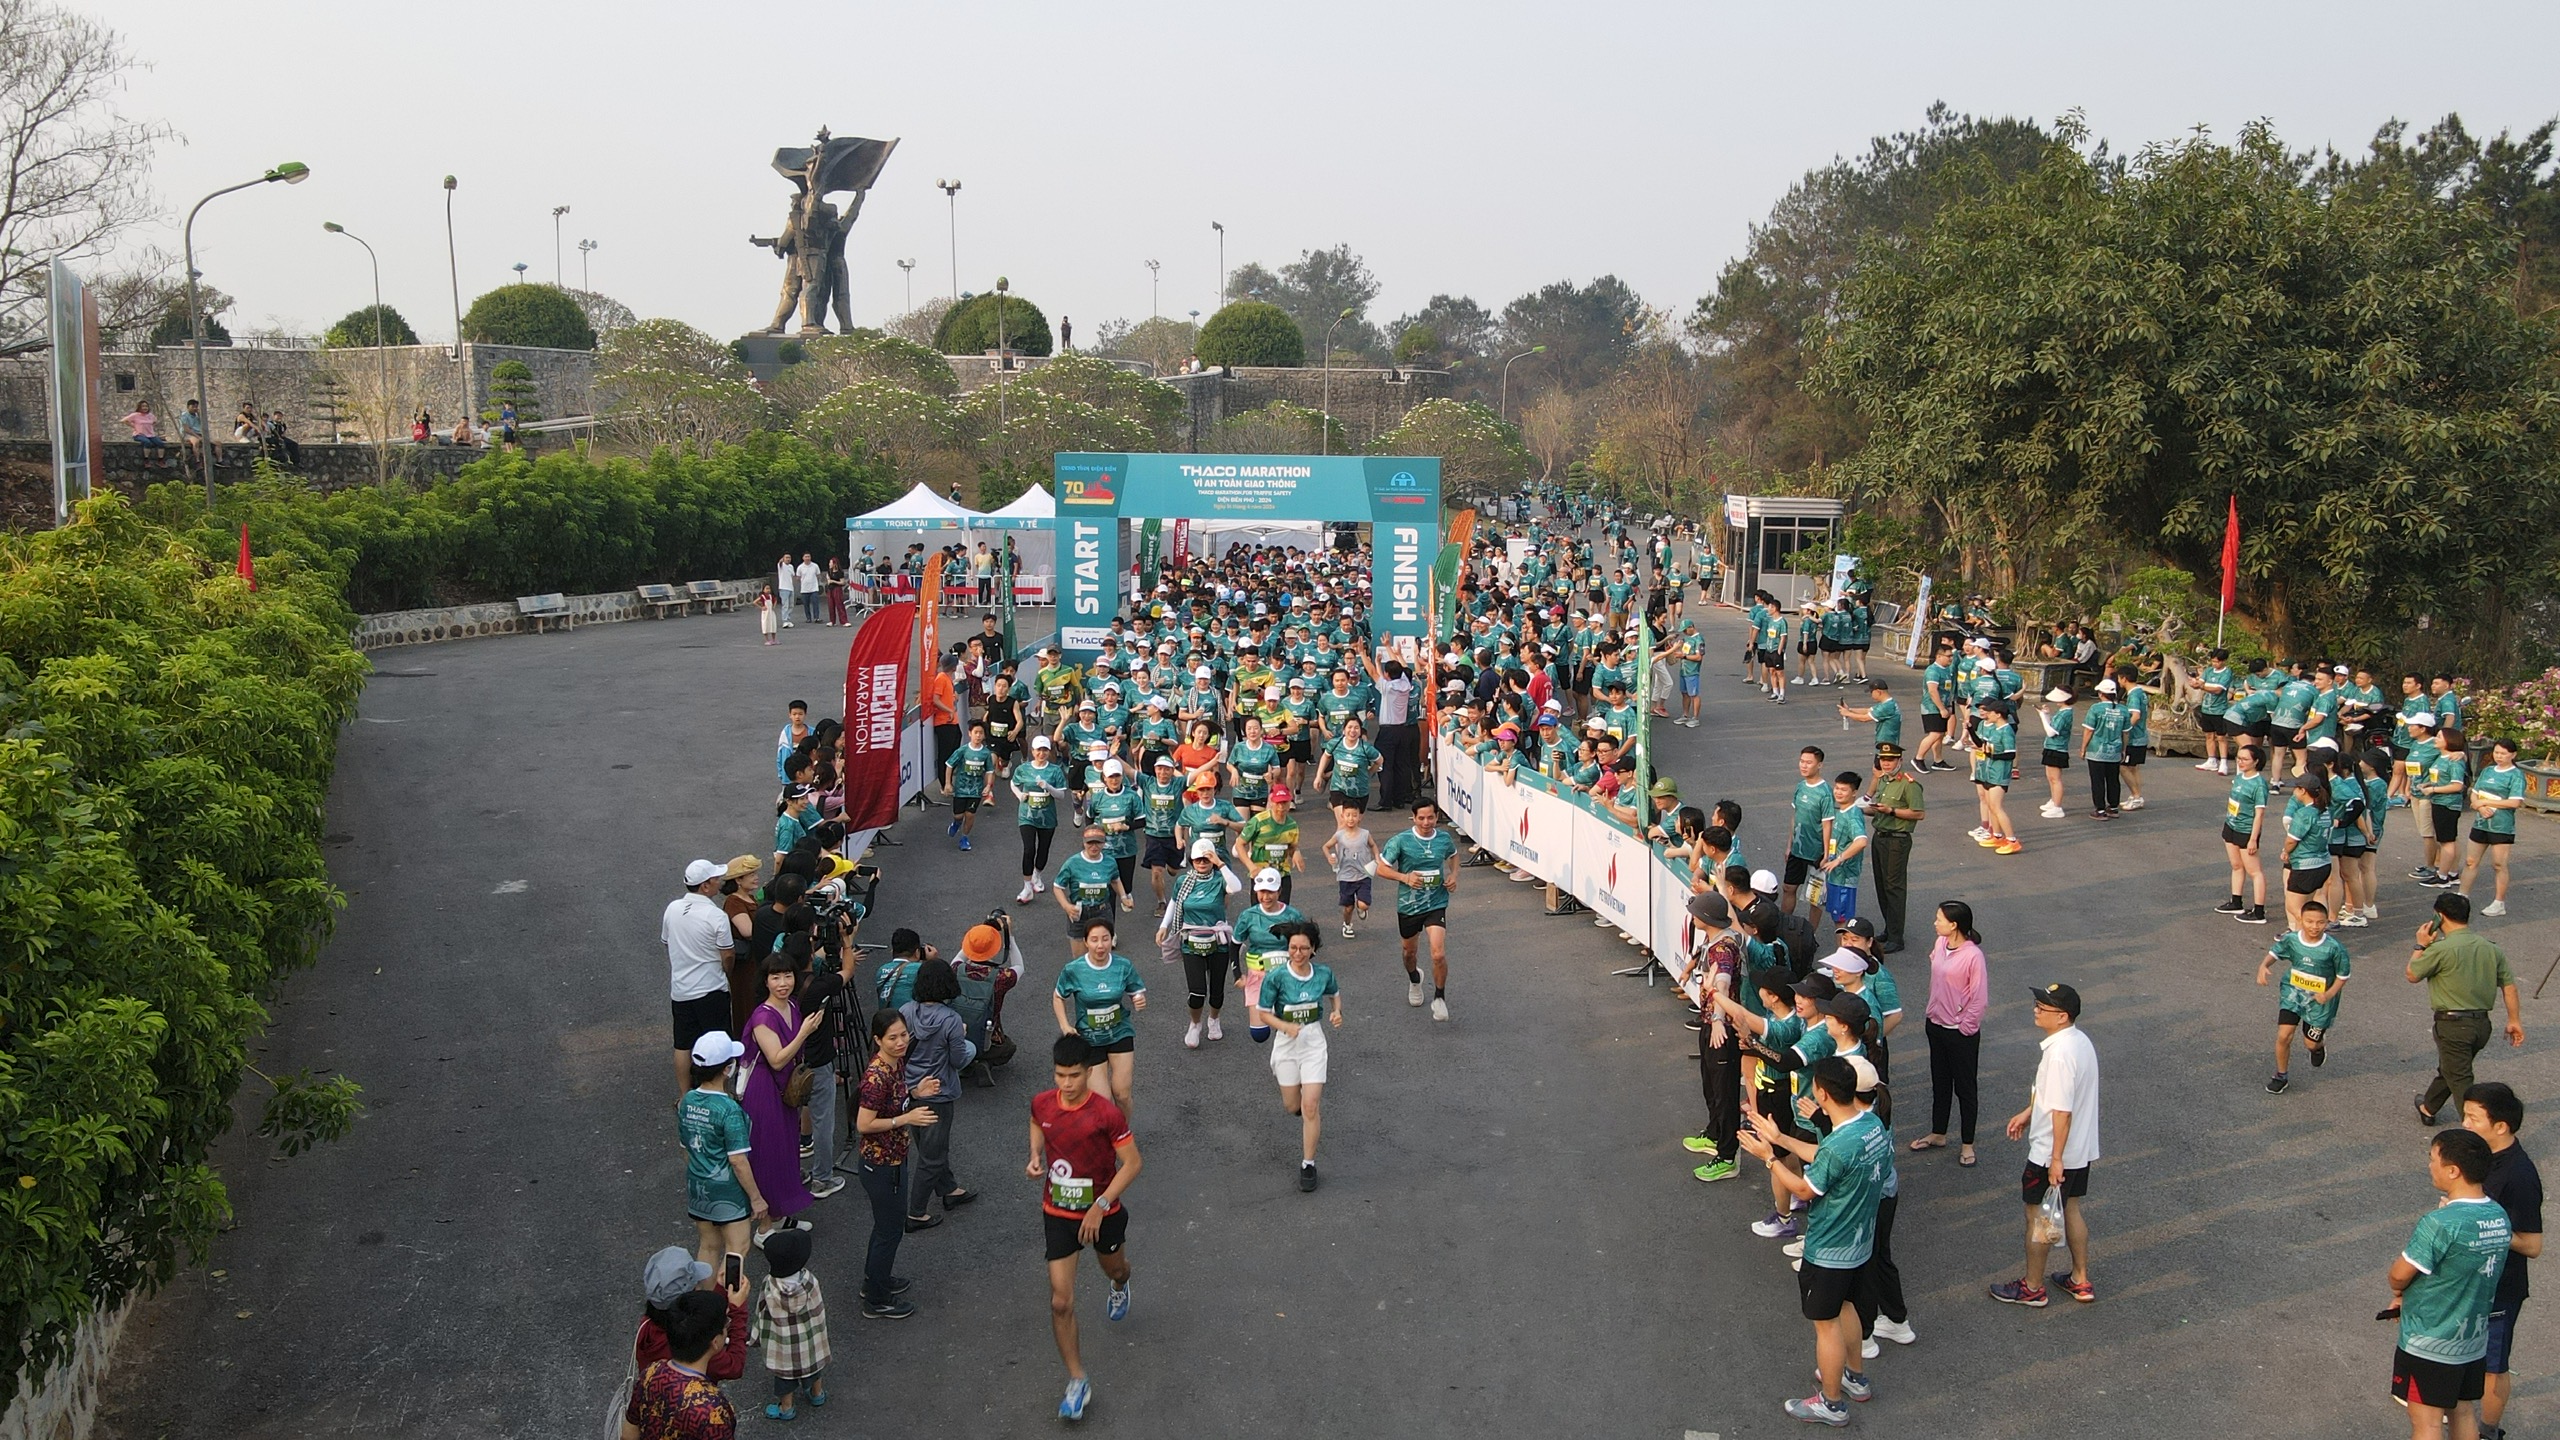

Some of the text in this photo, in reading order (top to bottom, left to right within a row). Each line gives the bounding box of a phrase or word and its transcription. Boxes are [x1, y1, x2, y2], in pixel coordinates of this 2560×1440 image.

[1180, 465, 1311, 477] THACO MARATHON
[1063, 481, 1084, 494] 70
[1193, 477, 1297, 488] VÌ AN TOÀN GIAO THÔNG
[884, 520, 912, 529] TRỌNG
[1019, 519, 1038, 528] Y TẾ
[1074, 521, 1099, 615] START
[1393, 527, 1418, 621] FINISH
[855, 667, 870, 754] MARATHON
[870, 664, 898, 750] DISCOVERY
[1446, 776, 1473, 815] THACO
[1509, 839, 1539, 865] PETROVIETNAM
[1598, 888, 1626, 917] PETROVIETNAM
[686, 1104, 710, 1116] THACO
[2476, 1217, 2506, 1229] THACO
